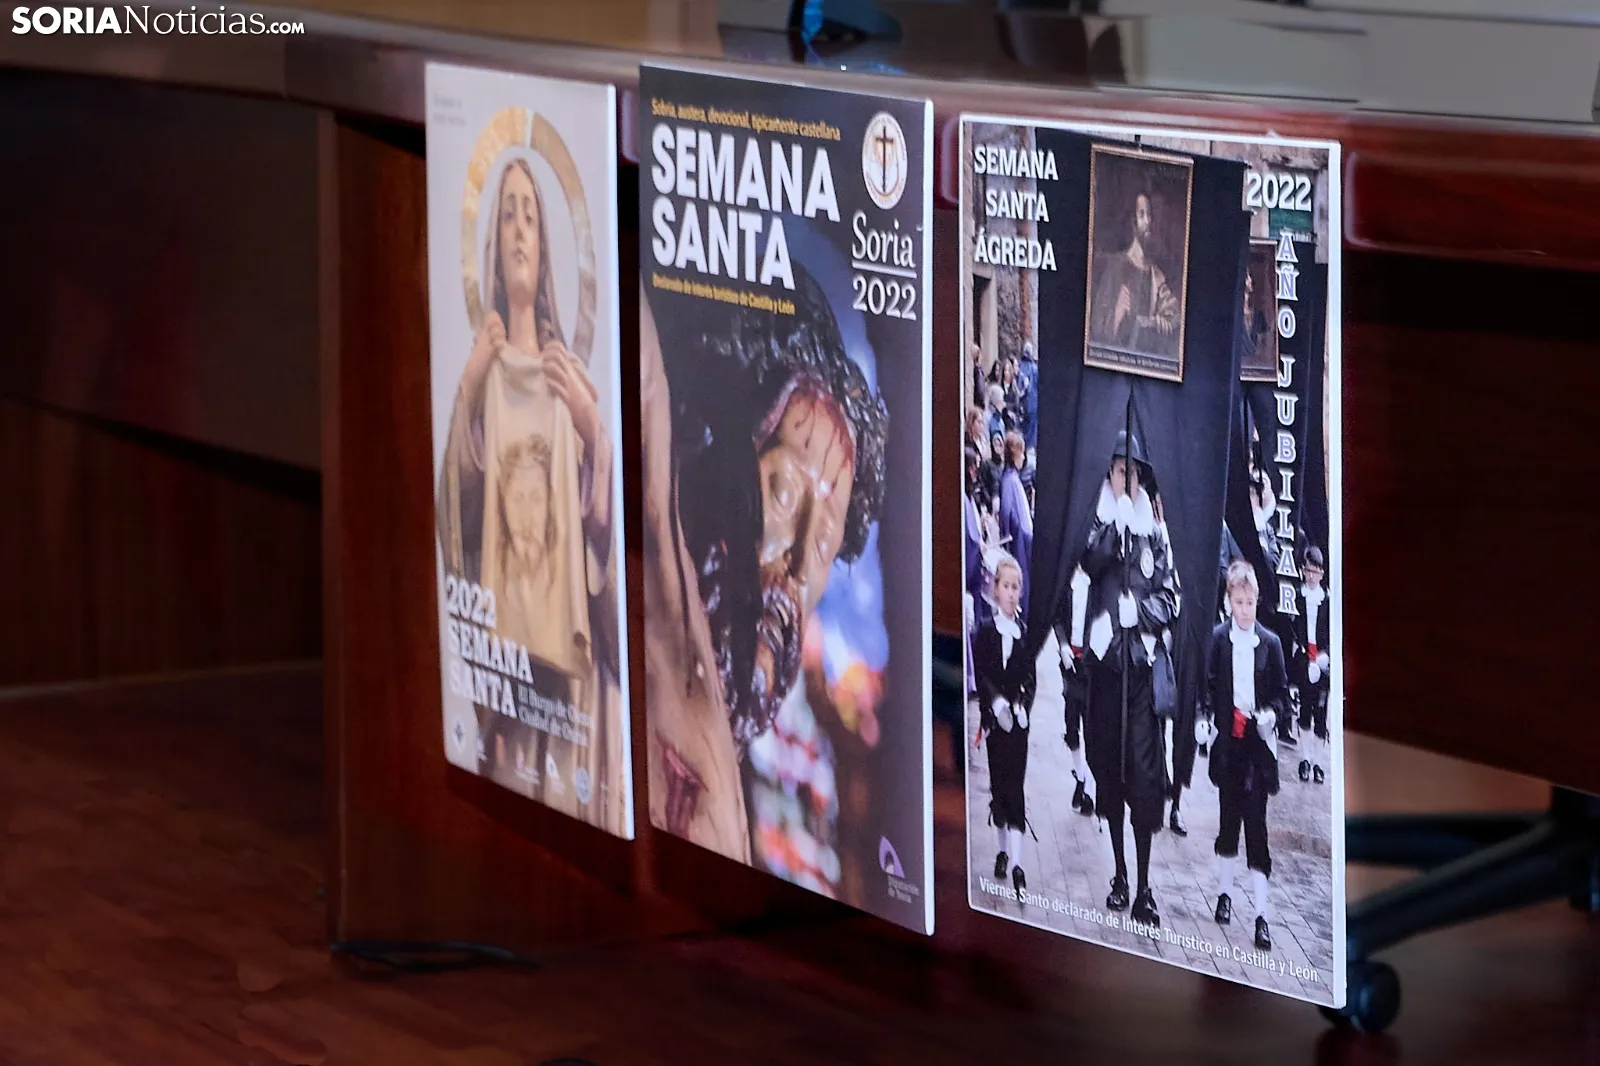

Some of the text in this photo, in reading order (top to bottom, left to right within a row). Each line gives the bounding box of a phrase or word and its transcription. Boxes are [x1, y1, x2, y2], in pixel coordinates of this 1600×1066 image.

[799, 120, 841, 141] castellana
[651, 122, 841, 223] SEMANA
[974, 145, 1058, 181] SEMANA
[985, 189, 1050, 223] SANTA
[1245, 172, 1312, 212] 2022
[652, 195, 796, 291] SANTA
[851, 209, 916, 268] Soria
[974, 227, 1057, 271] ÁGREDA
[852, 274, 916, 321] 2022
[1273, 231, 1300, 616] AÑO JUBILAR
[446, 575, 496, 629] 2022
[447, 618, 533, 684] SEMANA
[449, 658, 518, 719] SANTA
[979, 876, 1018, 900] Viernes
[1018, 888, 1049, 909] Santo
[1052, 899, 1103, 924] declarado
[1106, 914, 1119, 928] de
[1122, 918, 1161, 940] Interés
[1215, 944, 1229, 959] en
[1233, 947, 1276, 972] Castilla
[1279, 962, 1286, 977] y
[1289, 962, 1318, 983] León
